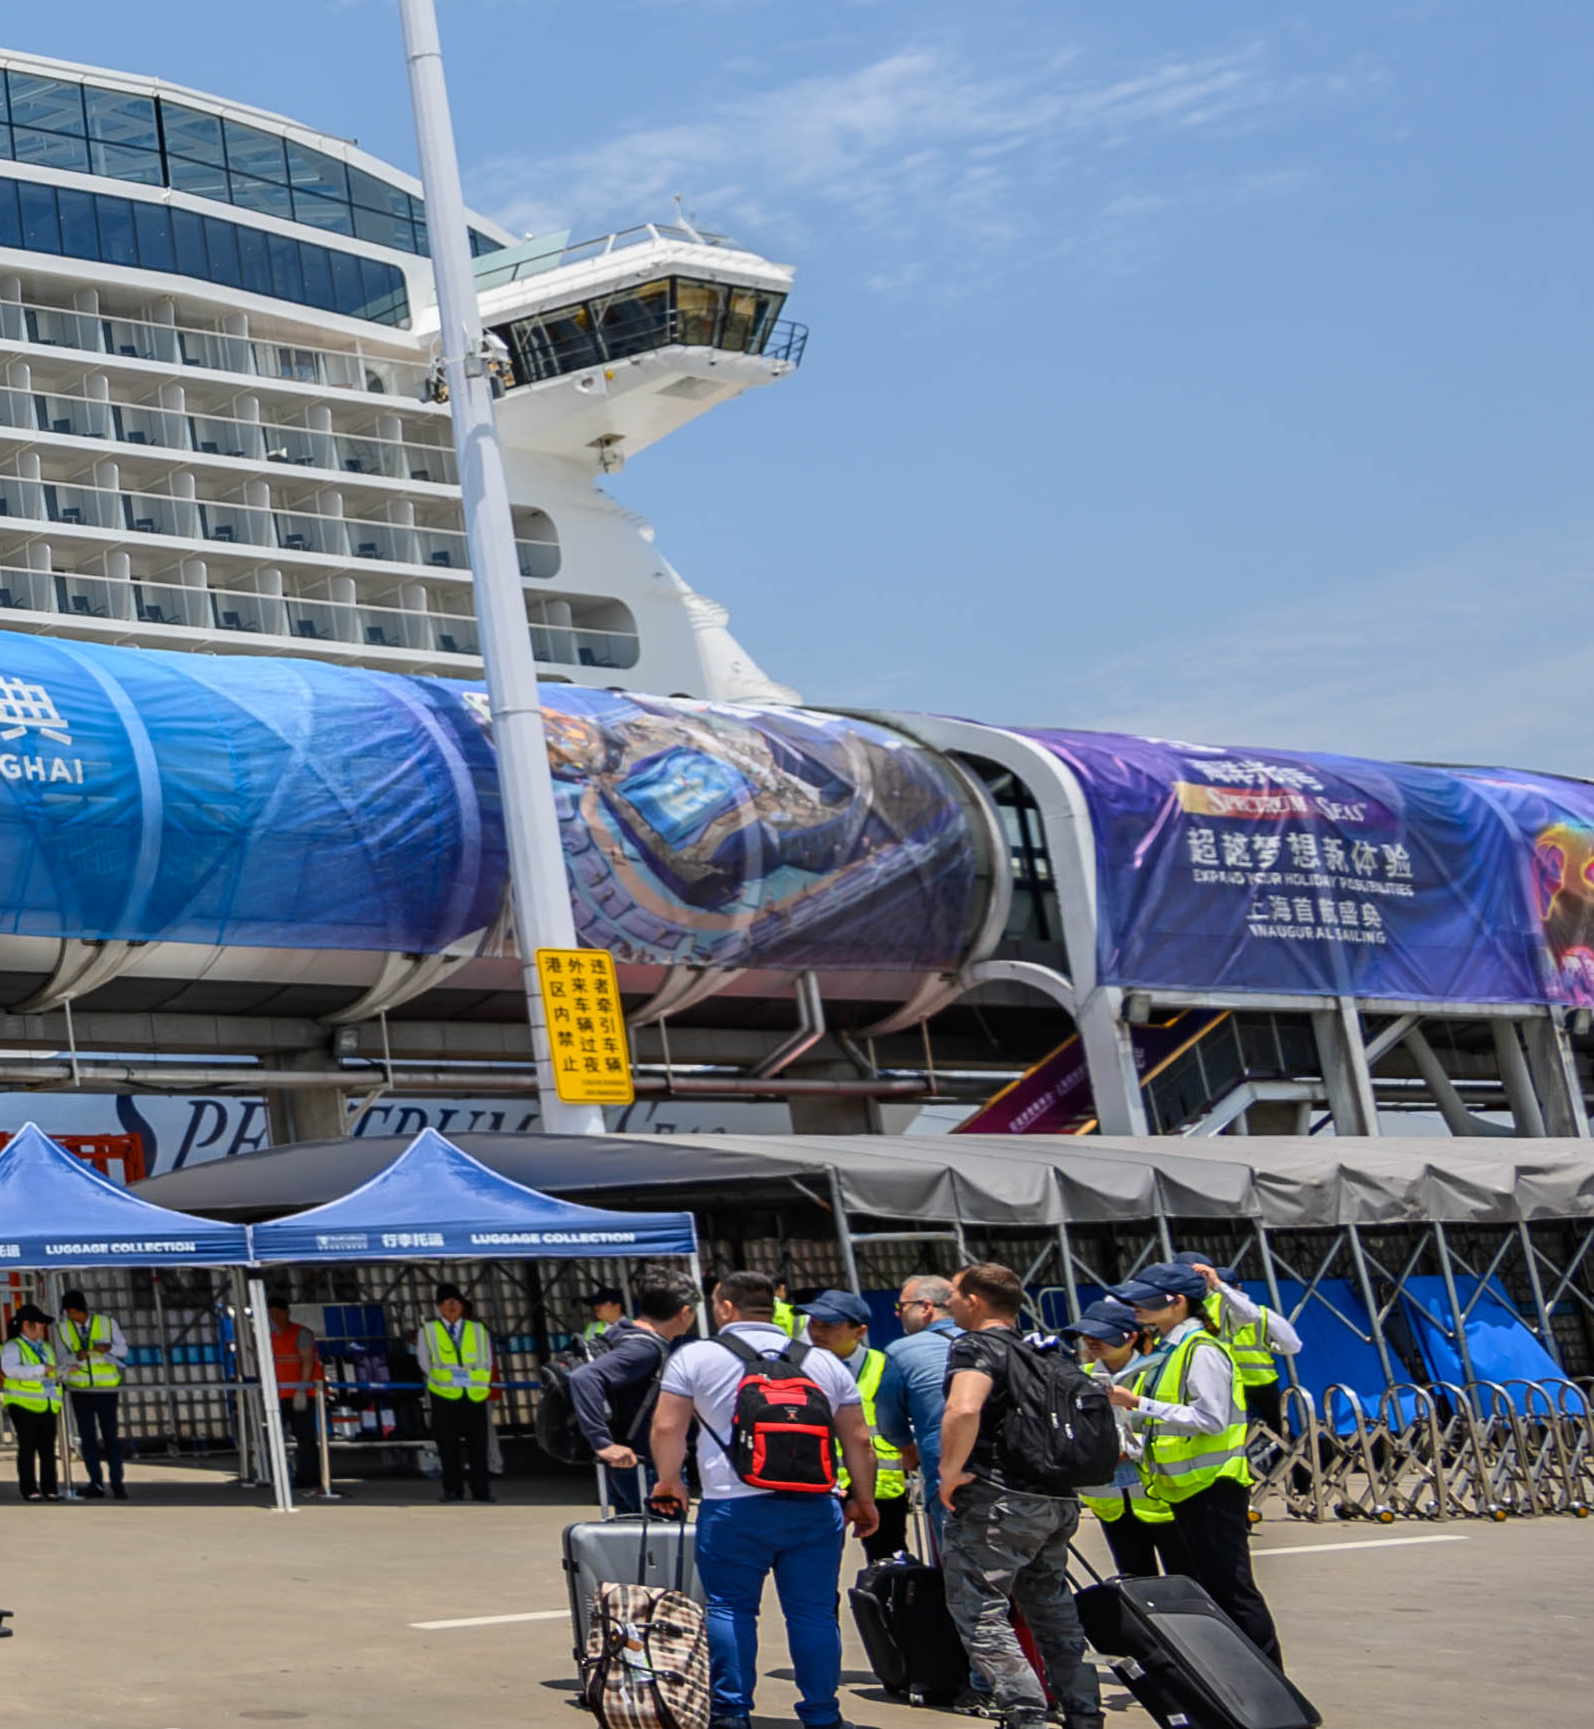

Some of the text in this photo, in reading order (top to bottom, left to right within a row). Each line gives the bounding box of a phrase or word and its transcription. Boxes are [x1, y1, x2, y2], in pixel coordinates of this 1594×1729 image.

[545, 956, 579, 1072] 港区内禁止
[568, 957, 599, 1073] 外来车辆过夜
[590, 957, 623, 1073] 违者牵引车辆
[45, 1241, 196, 1255] LUGGAGE COLLECTION
[471, 1231, 636, 1245] LUGGAGE COLLECTION
